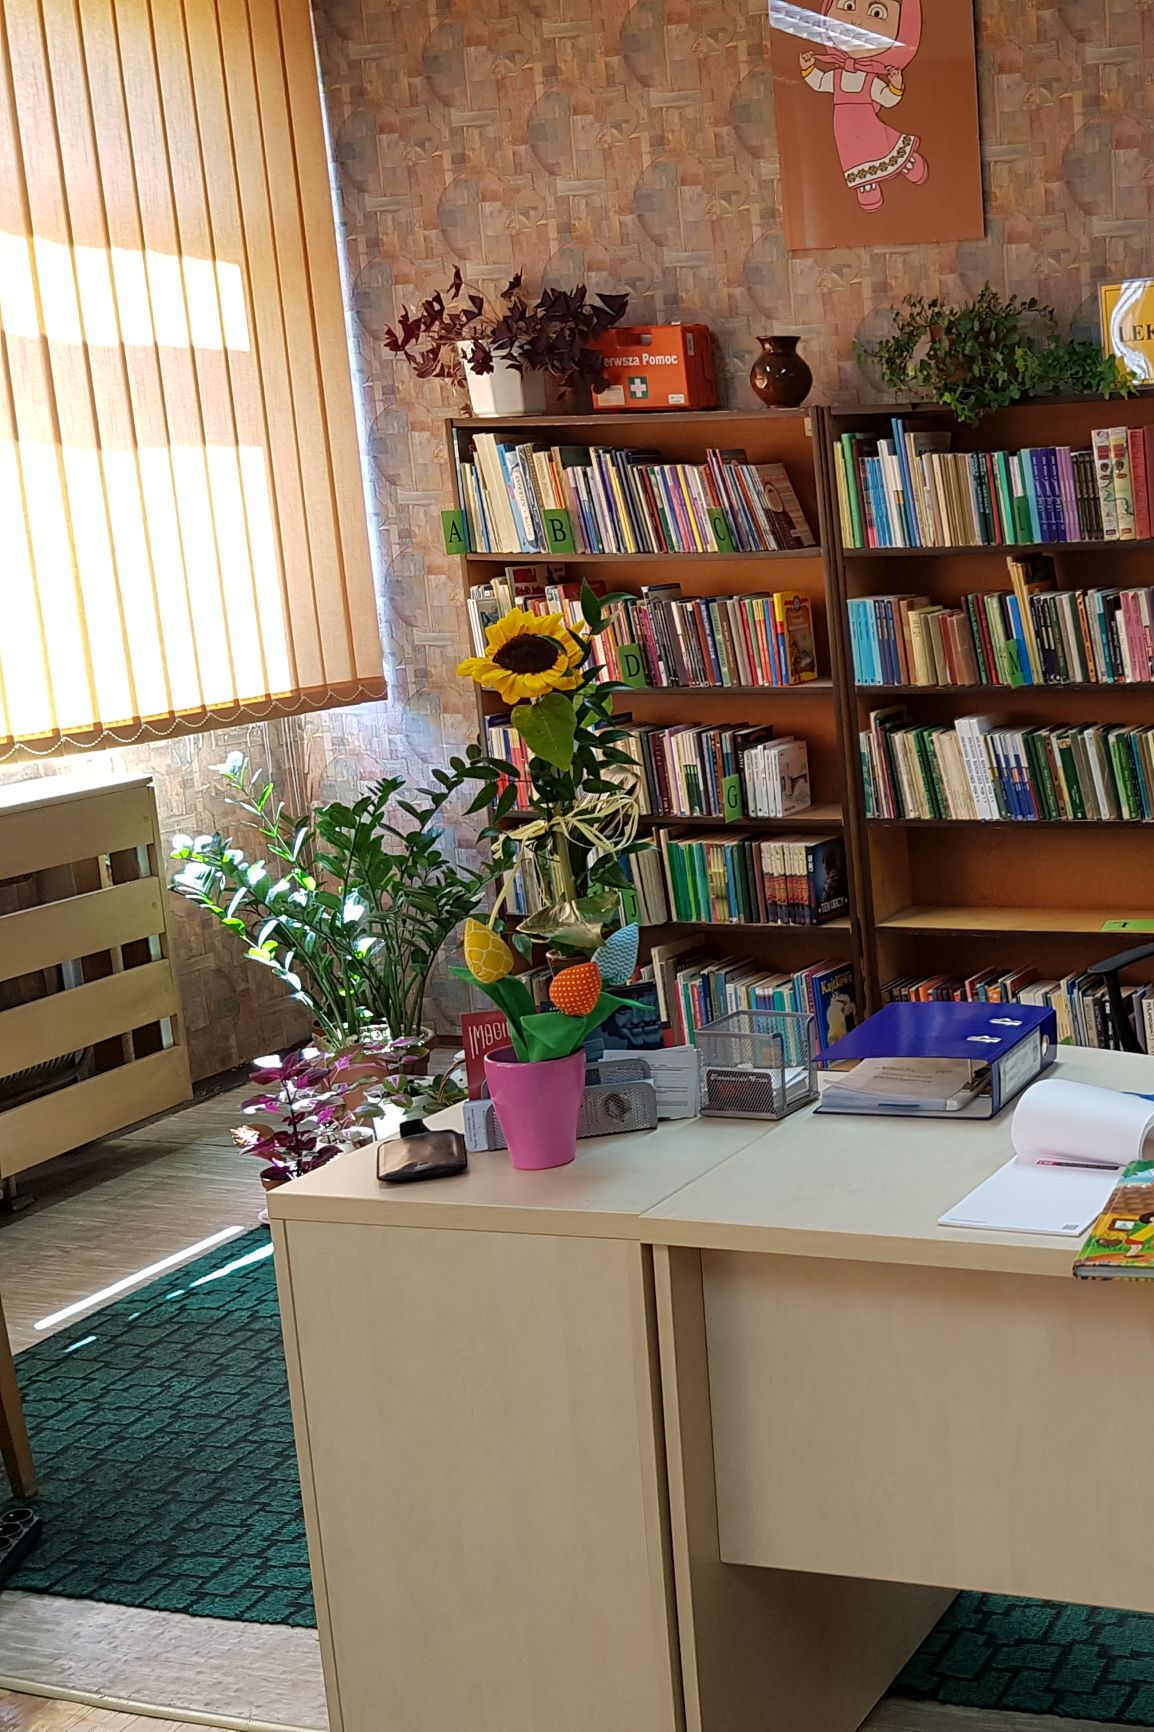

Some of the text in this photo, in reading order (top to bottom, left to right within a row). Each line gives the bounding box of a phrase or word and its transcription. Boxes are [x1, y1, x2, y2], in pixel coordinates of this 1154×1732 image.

[601, 353, 678, 367] erwsza Pomoc
[449, 519, 464, 544] A
[550, 518, 566, 542] B
[713, 517, 726, 541] C
[626, 654, 640, 678] D
[1008, 644, 1022, 675] M
[727, 786, 738, 808] G
[630, 896, 637, 918] J
[468, 1022, 511, 1060] IMAGI
